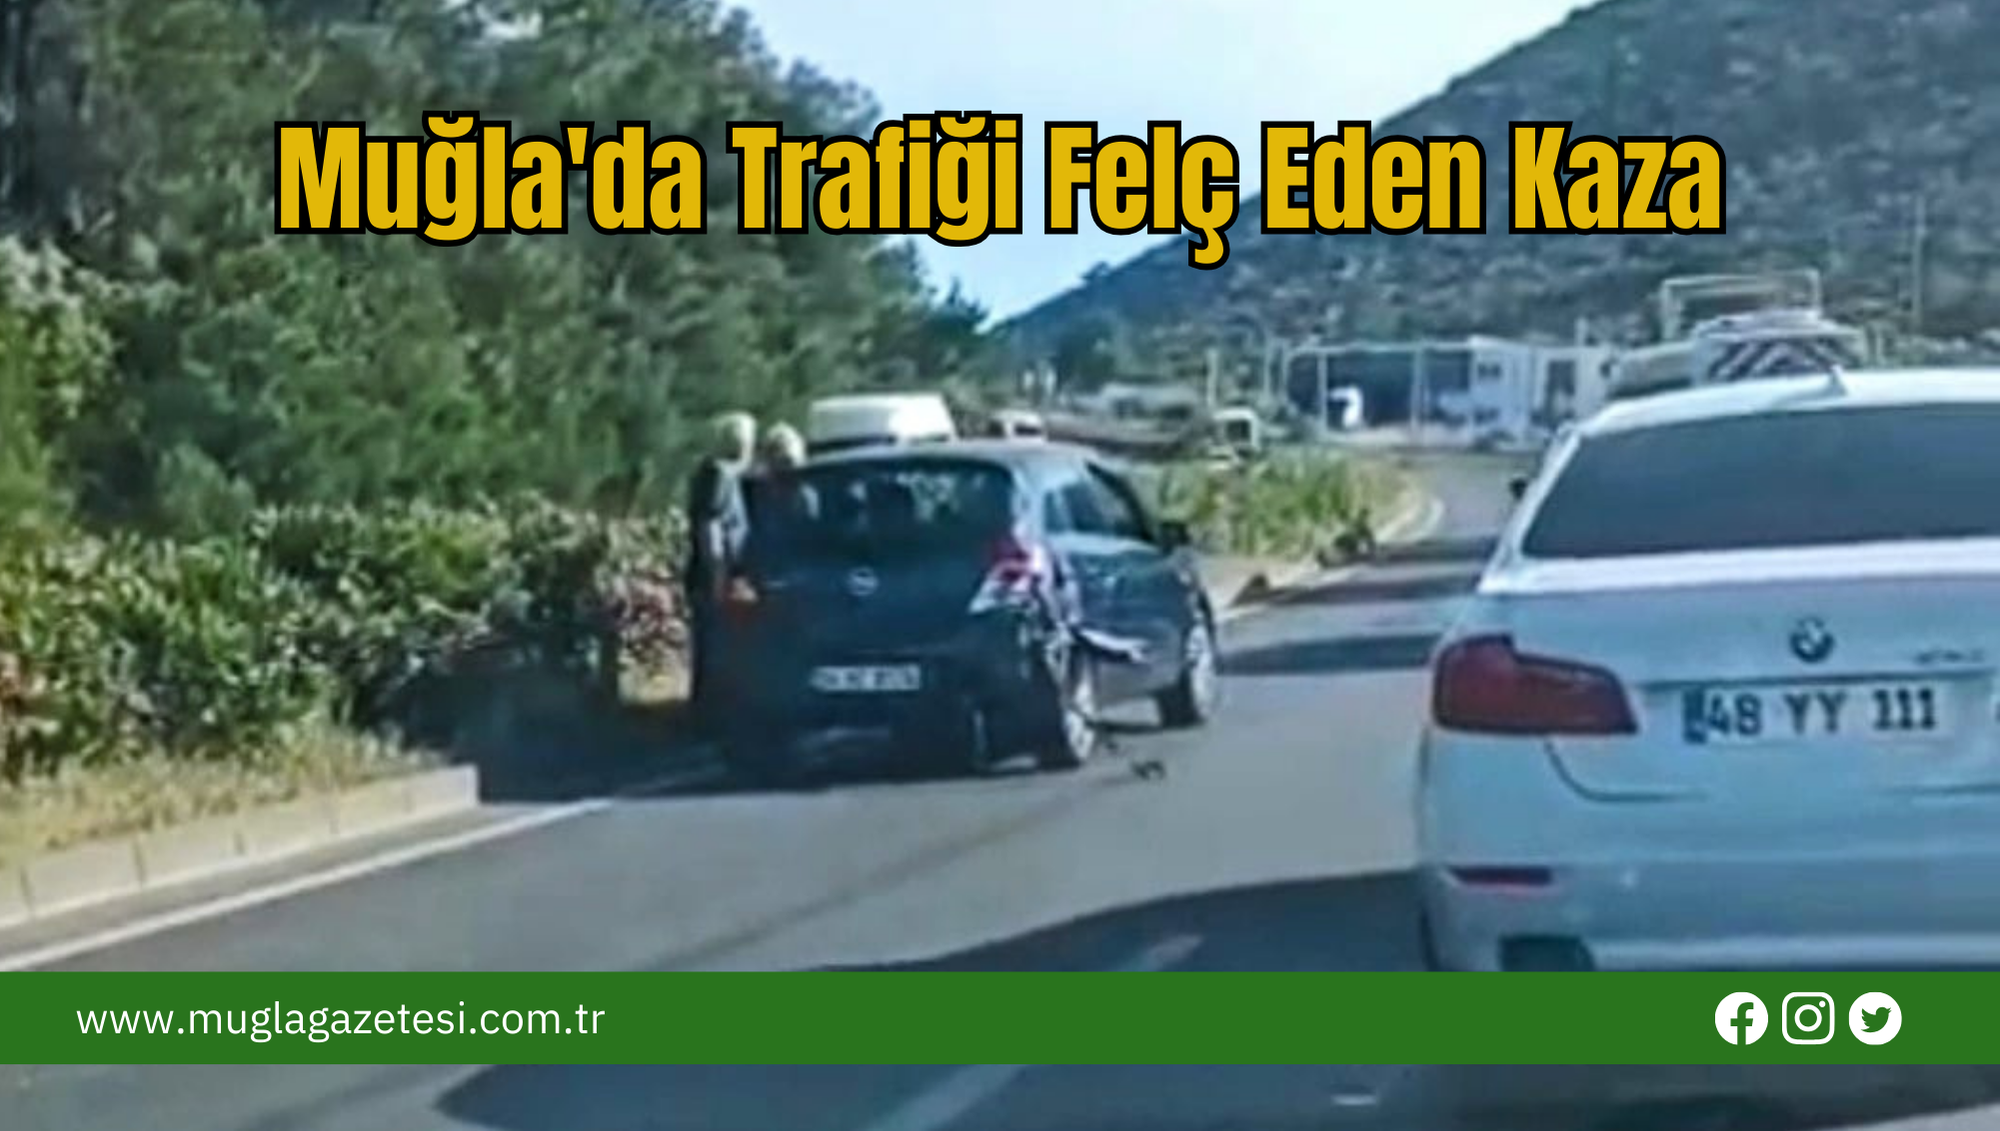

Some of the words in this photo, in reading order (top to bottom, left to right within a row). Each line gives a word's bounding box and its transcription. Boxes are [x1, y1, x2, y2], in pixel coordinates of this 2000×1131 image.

[1708, 692, 1763, 735] 48
[1783, 690, 1847, 734] YY
[1872, 687, 1936, 731] 111
